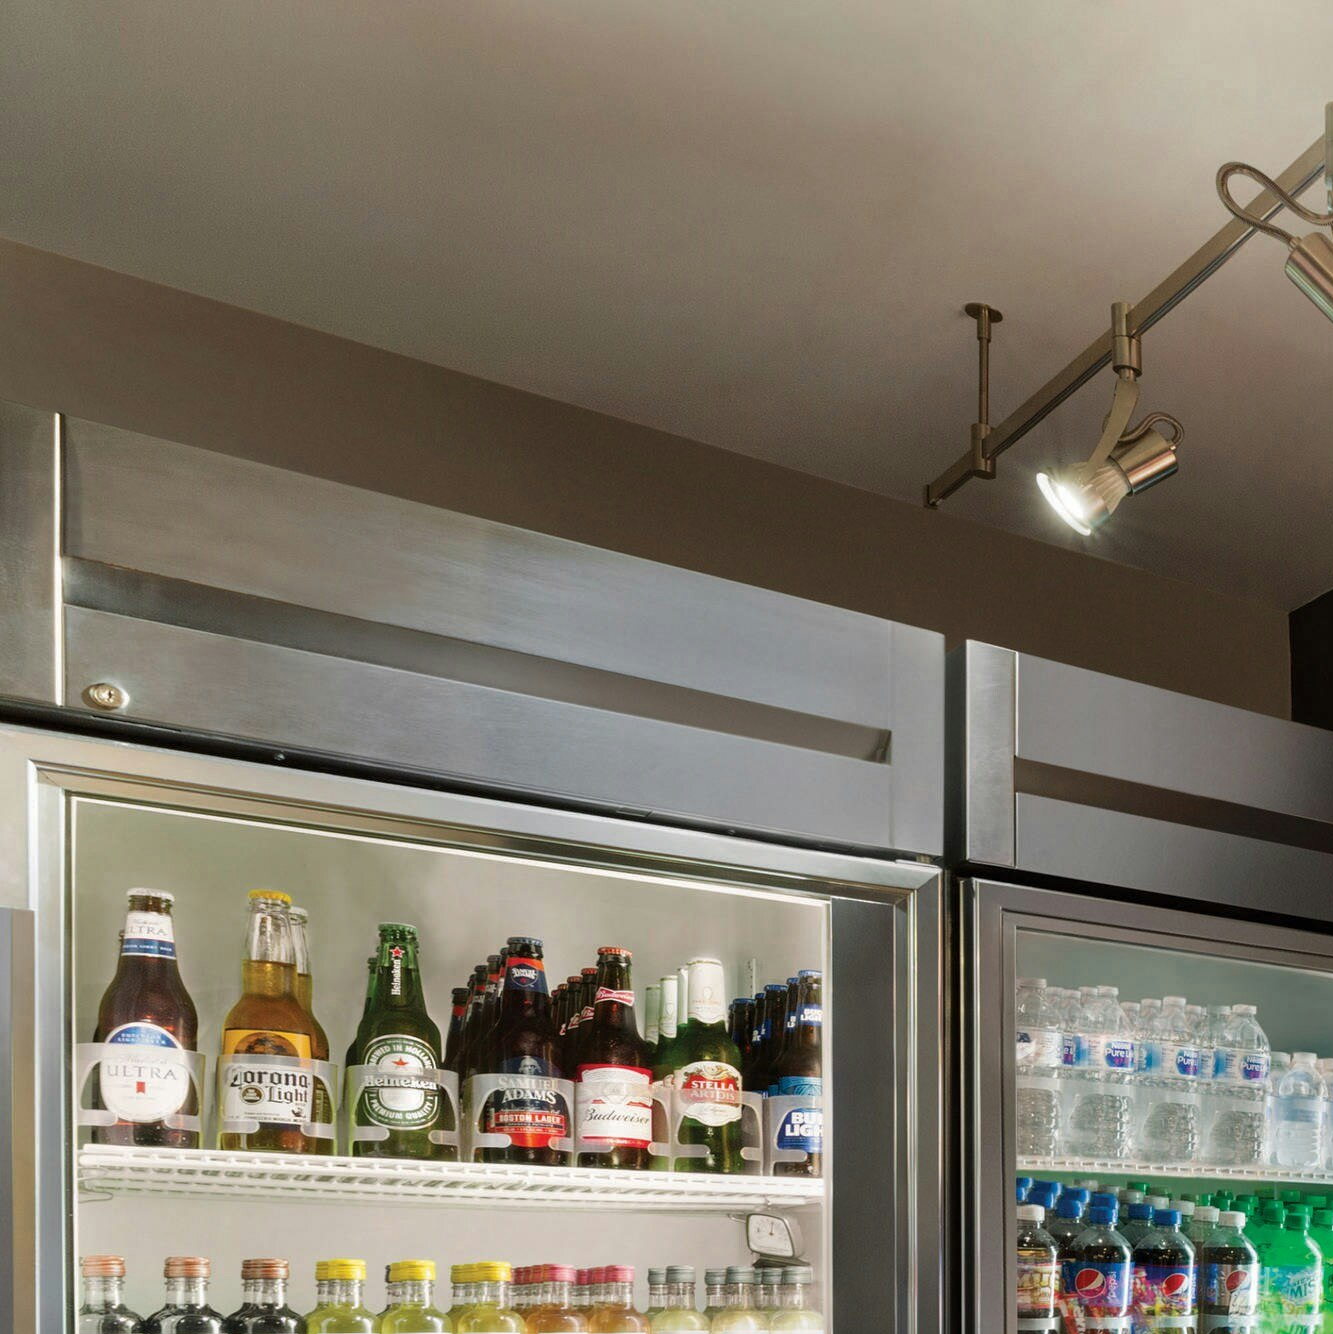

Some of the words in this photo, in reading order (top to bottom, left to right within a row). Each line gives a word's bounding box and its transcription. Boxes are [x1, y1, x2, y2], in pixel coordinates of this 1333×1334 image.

[231, 1066, 309, 1089] Corona
[691, 1079, 735, 1092] STELLA
[266, 1085, 309, 1104] Light
[502, 1090, 558, 1105] ADAMS
